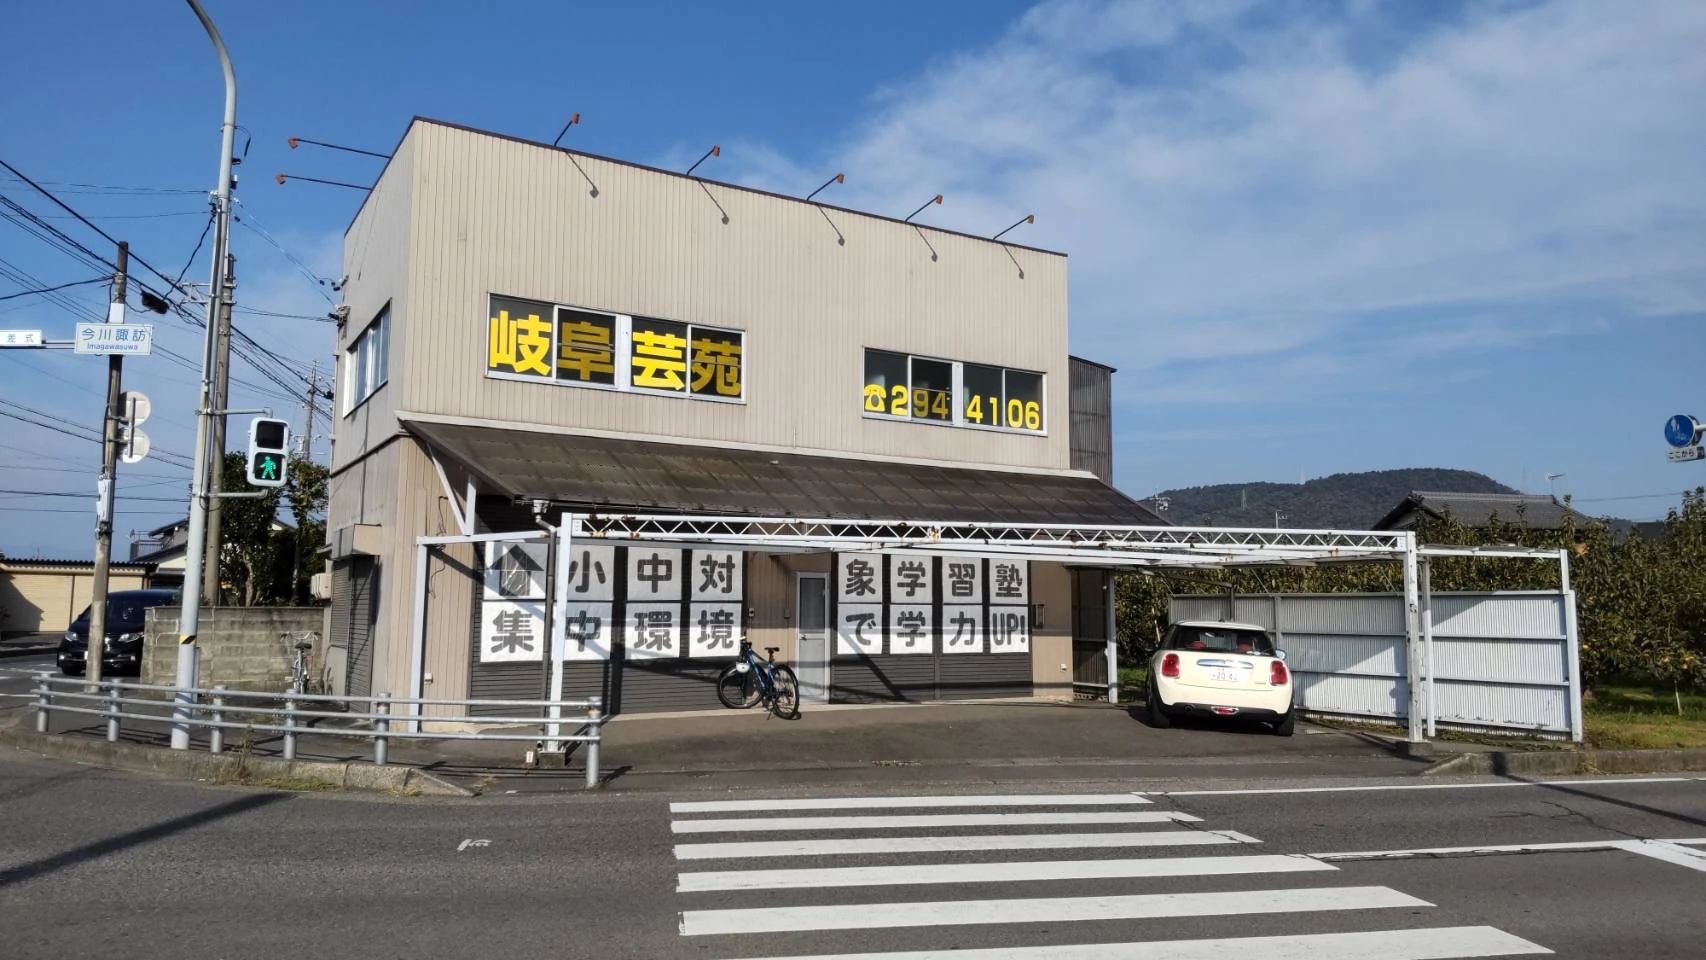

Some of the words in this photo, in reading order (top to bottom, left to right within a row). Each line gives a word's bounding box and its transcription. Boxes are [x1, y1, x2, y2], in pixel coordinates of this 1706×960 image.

[82, 328, 146, 342] 今川諏訪
[87, 343, 139, 351] Imagawasuwa
[489, 310, 742, 396] 岐阜芸苑
[891, 385, 949, 420] 294
[966, 394, 1040, 430] 4106
[568, 550, 736, 594] 小中対
[845, 559, 1023, 598] 象学習塾
[491, 609, 735, 653] 集中環境
